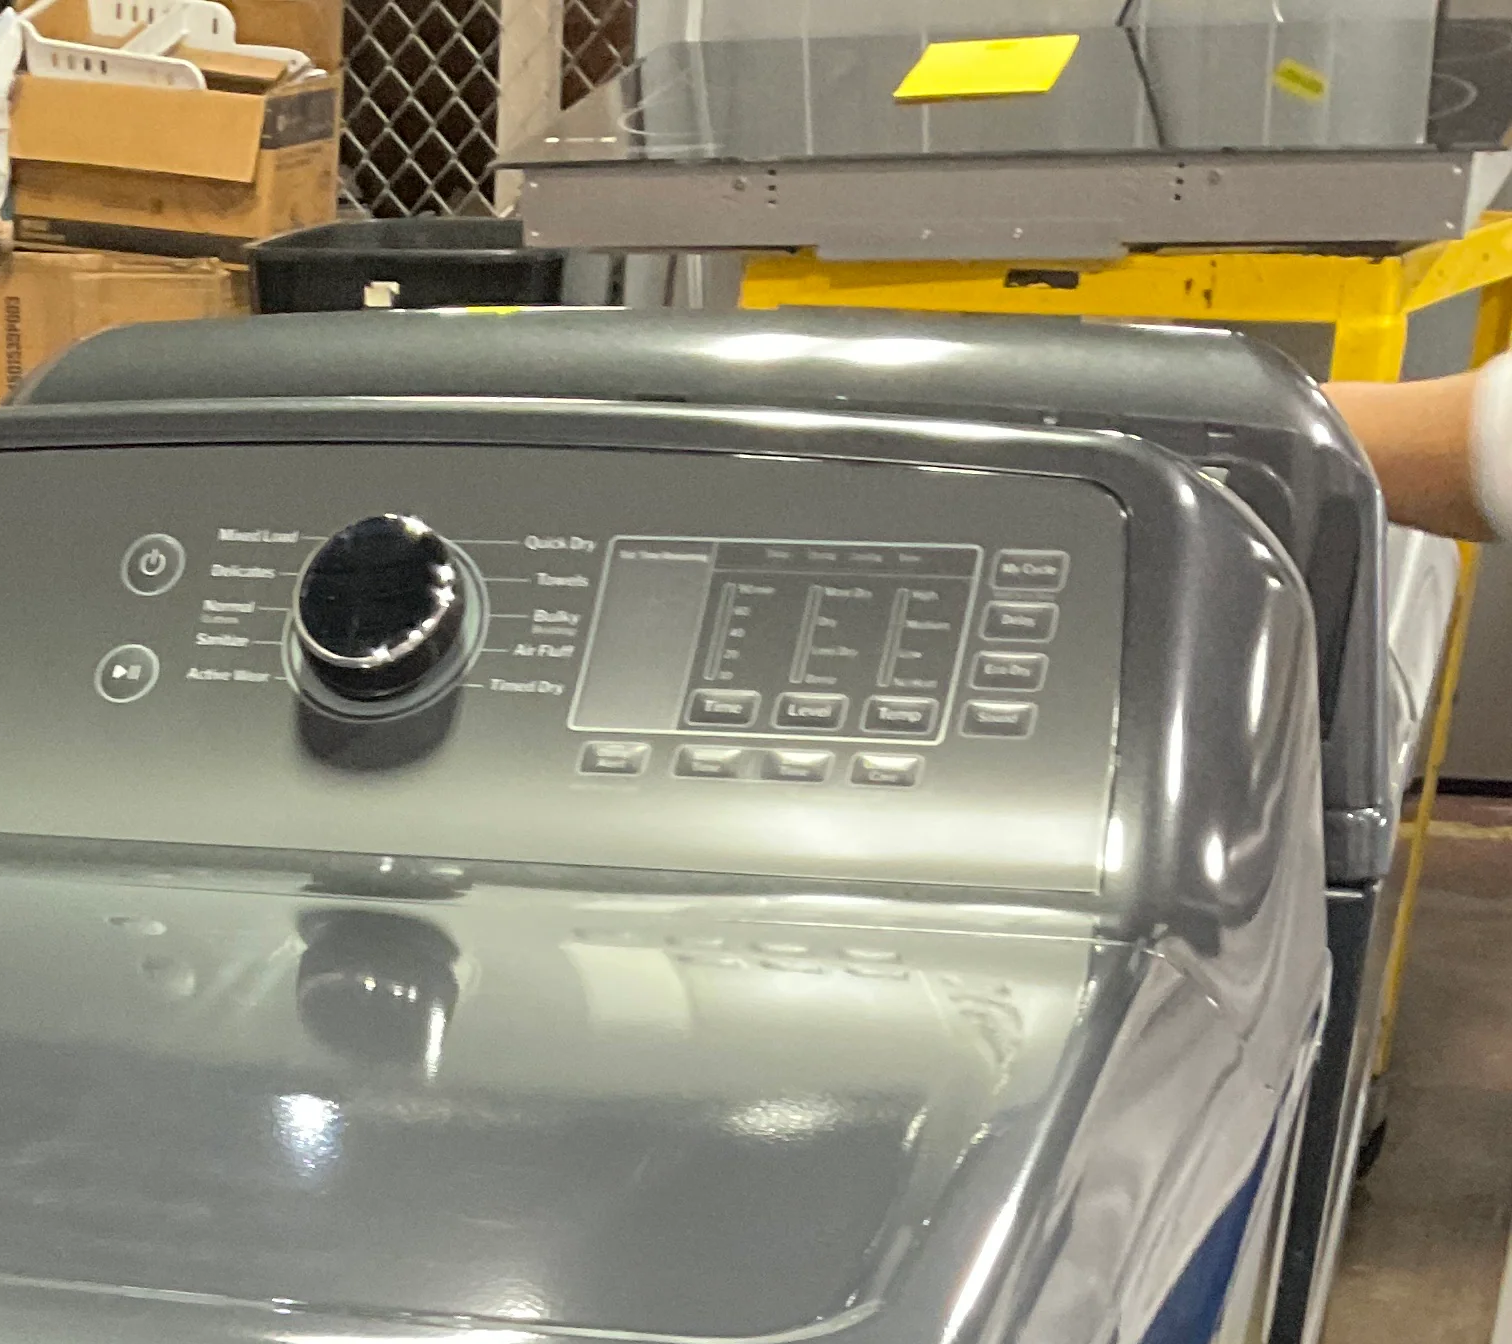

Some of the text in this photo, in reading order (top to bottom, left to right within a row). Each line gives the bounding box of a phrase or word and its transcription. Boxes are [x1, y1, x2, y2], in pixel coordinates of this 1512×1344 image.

[524, 535, 596, 553] Quick Dry
[537, 680, 565, 696] Dry
